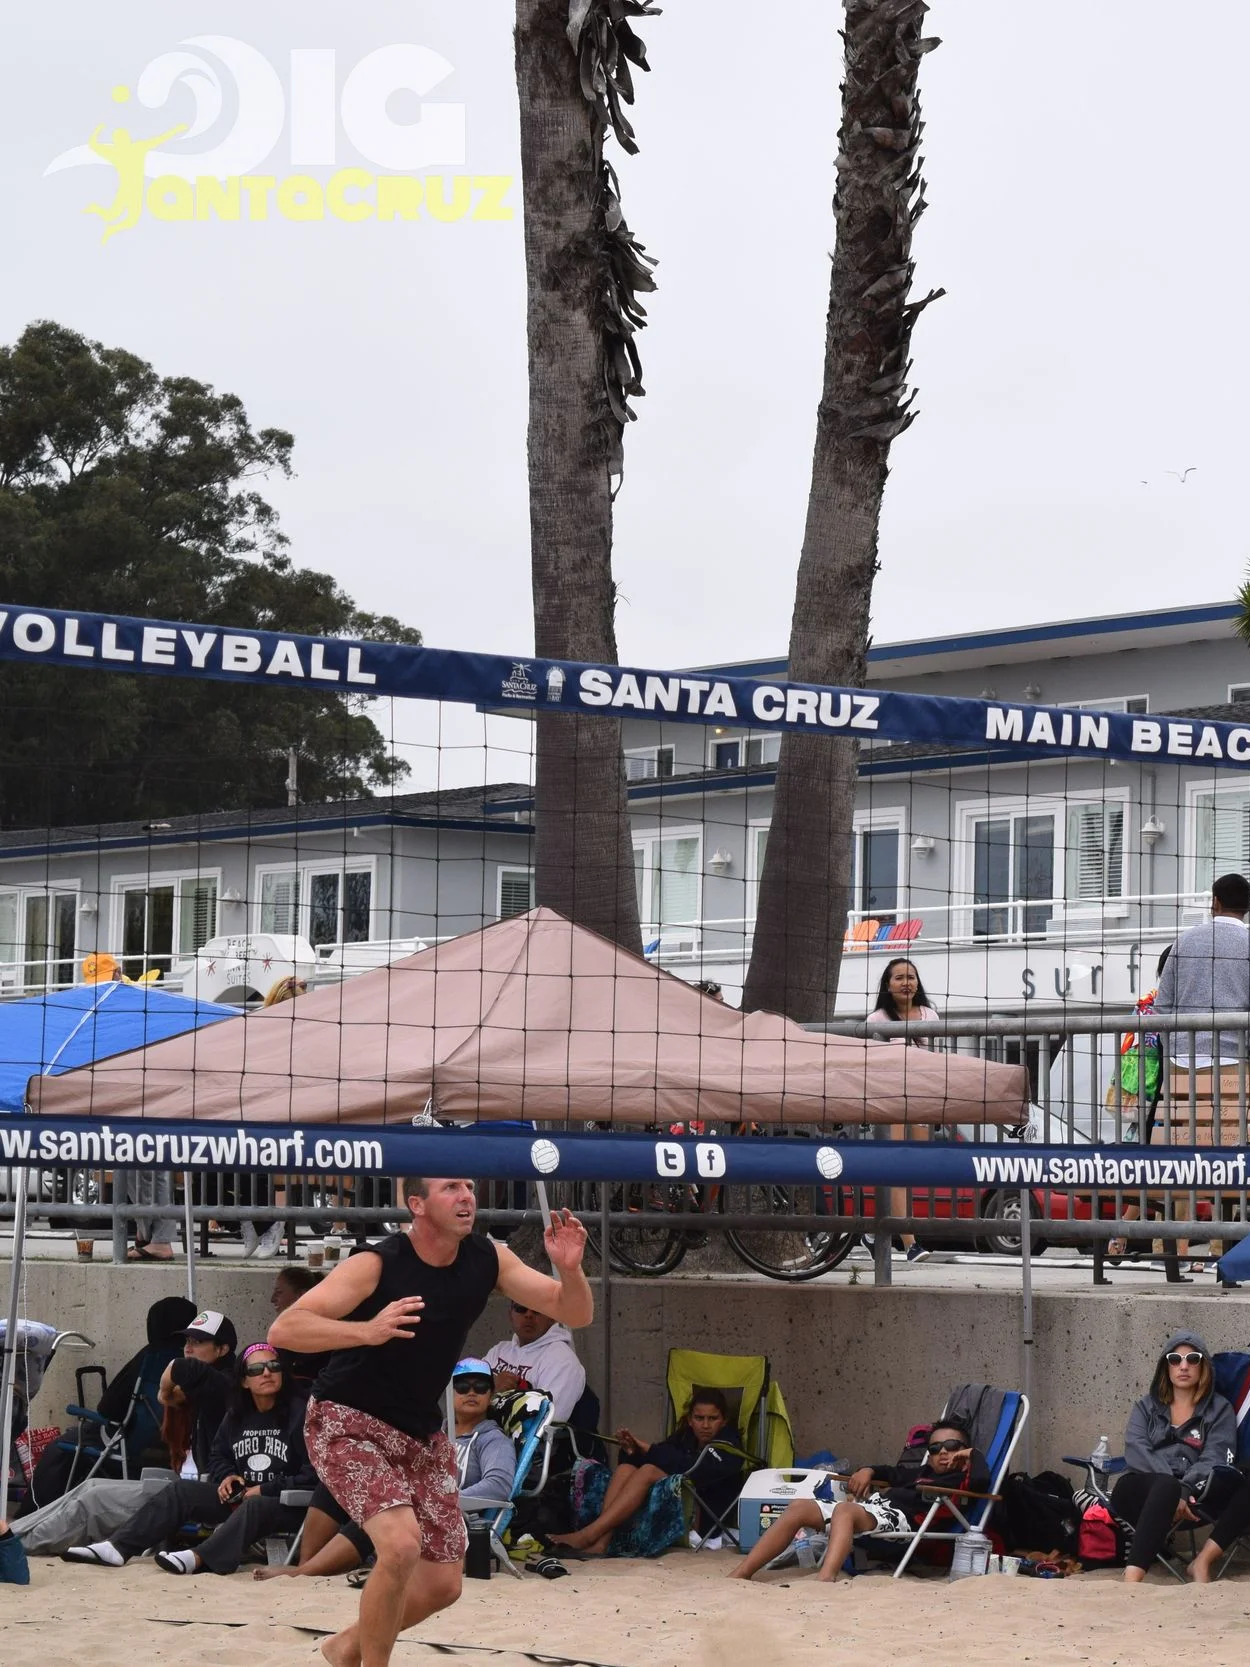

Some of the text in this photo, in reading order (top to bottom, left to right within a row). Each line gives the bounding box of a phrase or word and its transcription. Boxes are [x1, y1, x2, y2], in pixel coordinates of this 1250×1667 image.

[0, 611, 377, 685] OLLEYBALL
[579, 669, 738, 718] SANTA
[751, 684, 880, 731] CRUZ
[985, 707, 1110, 749] MAIN
[1022, 943, 1139, 999] surf
[0, 1126, 382, 1169] w.santacruzwharf.com
[232, 1436, 288, 1463] TORO PARK
